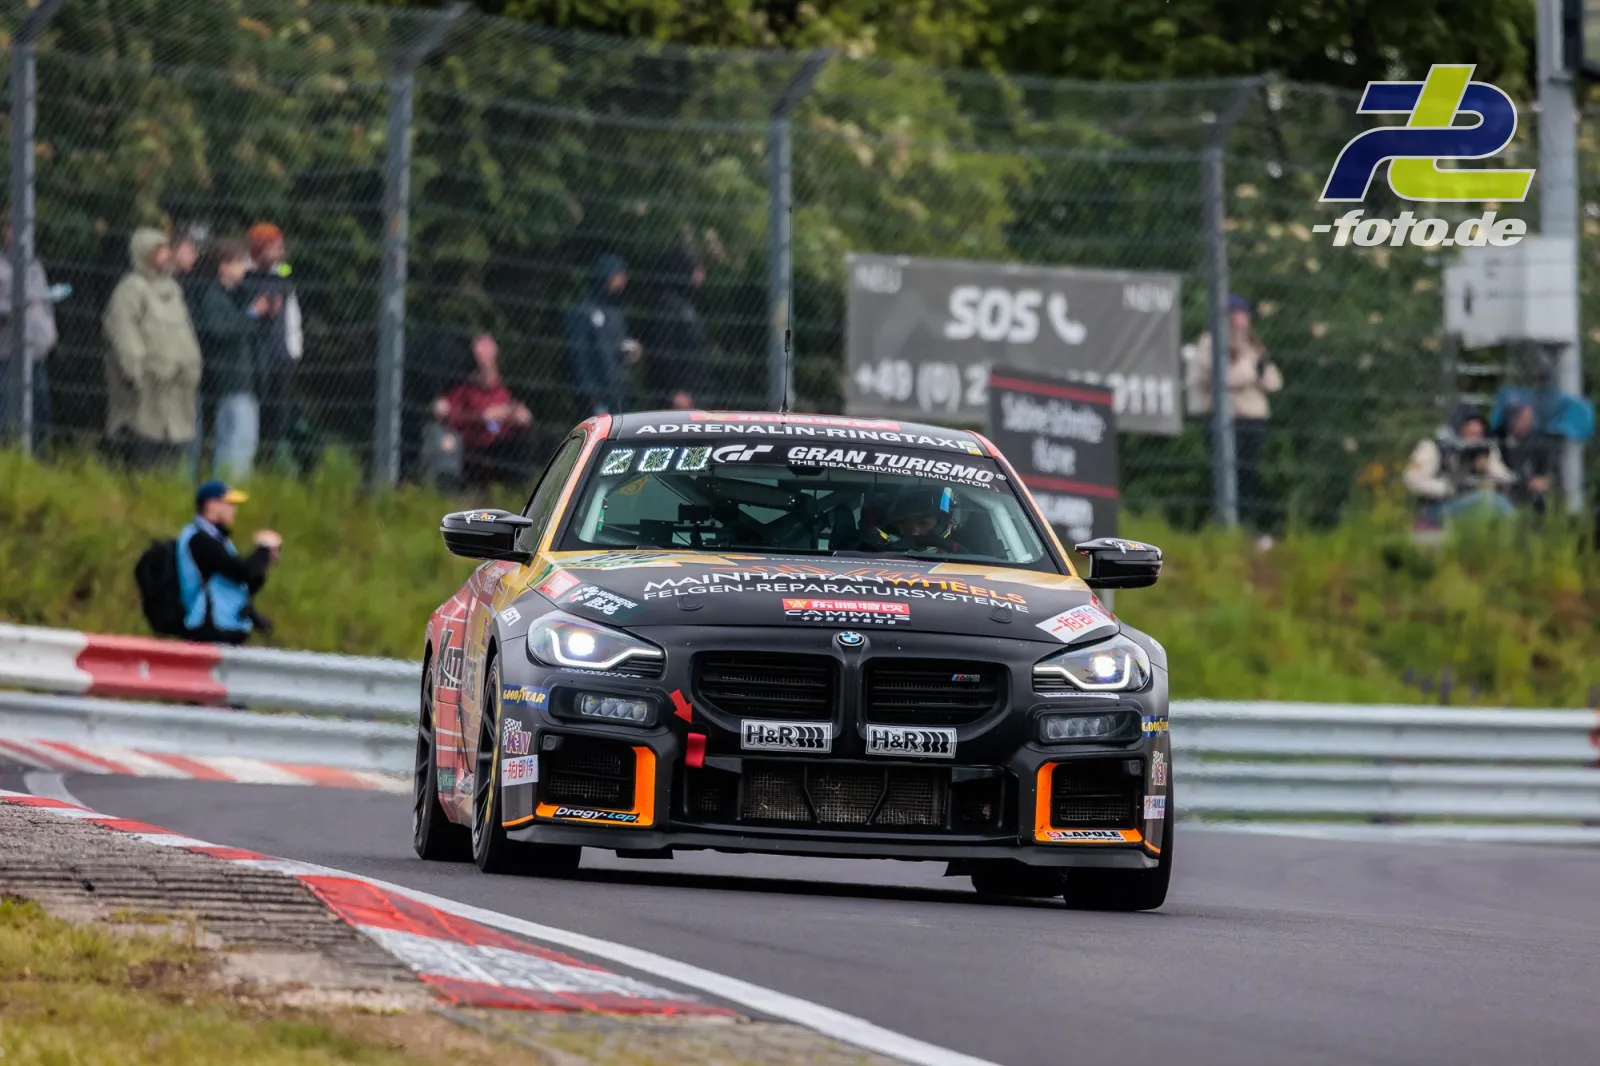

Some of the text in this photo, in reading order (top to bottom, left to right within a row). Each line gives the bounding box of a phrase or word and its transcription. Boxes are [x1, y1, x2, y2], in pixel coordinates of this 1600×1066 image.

[945, 286, 1043, 344] SOS
[636, 424, 967, 450] ADRENALIN-RINGTAXI
[788, 446, 868, 466] GRAN
[789, 459, 991, 488] THE REAL DRIVING SIMULATOR
[644, 583, 1030, 613] FELGEN-REPARATURSYSTEME
[785, 610, 911, 621] CAMMUS
[503, 687, 546, 703] GOODYEAR
[506, 731, 532, 755] KW
[746, 724, 795, 746] H&R
[871, 729, 920, 751] H&R
